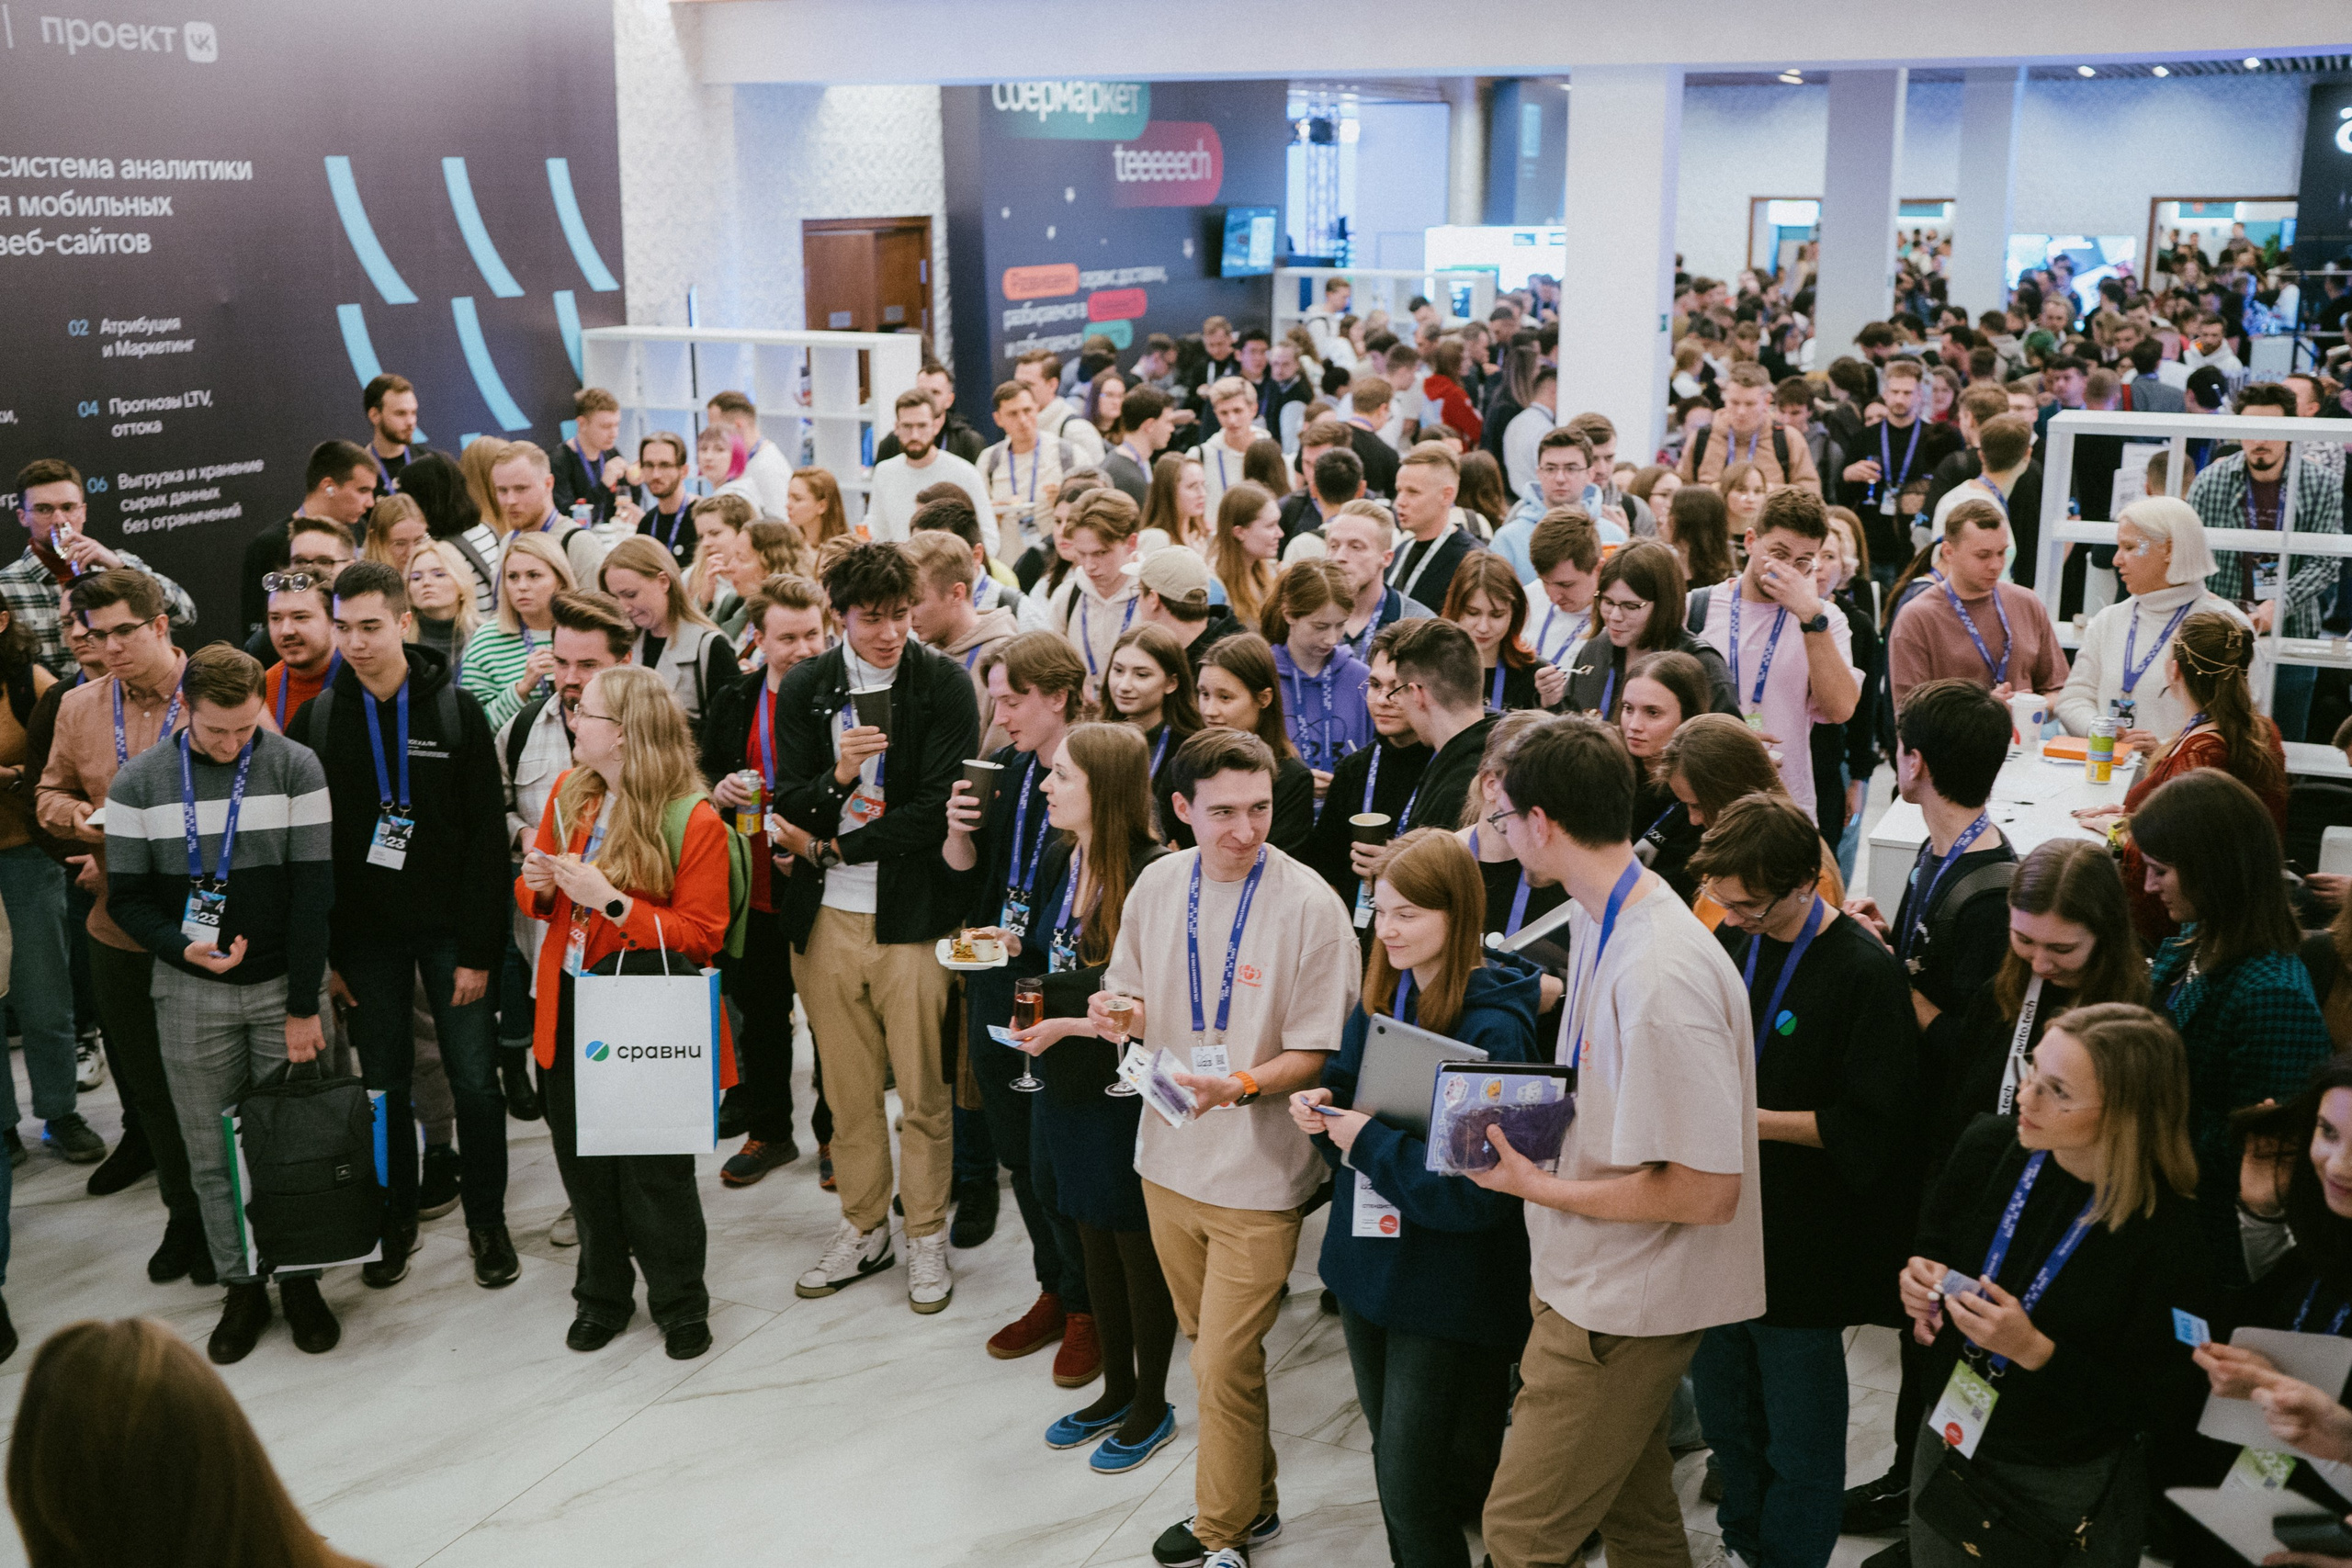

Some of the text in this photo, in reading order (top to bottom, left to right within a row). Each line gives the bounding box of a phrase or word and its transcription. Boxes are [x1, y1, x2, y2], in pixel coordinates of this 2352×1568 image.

[40, 16, 177, 55] проект
[120, 159, 253, 180] аналитики
[17, 189, 174, 217] мобильных
[68, 316, 181, 337] 02 Атрибуция
[102, 339, 196, 359] и Маркетинг
[77, 389, 214, 418] 04 Прогнозы LTV,
[111, 420, 163, 438] оттока
[86, 459, 265, 493] 06 Выгрузка и хранение
[119, 487, 220, 513] сырых данных
[122, 502, 243, 535] без ограничений
[386, 836, 407, 850] 23
[198, 911, 220, 926] 23
[2015, 999, 2036, 1055] avito.tech
[616, 1044, 701, 1062] сравни
